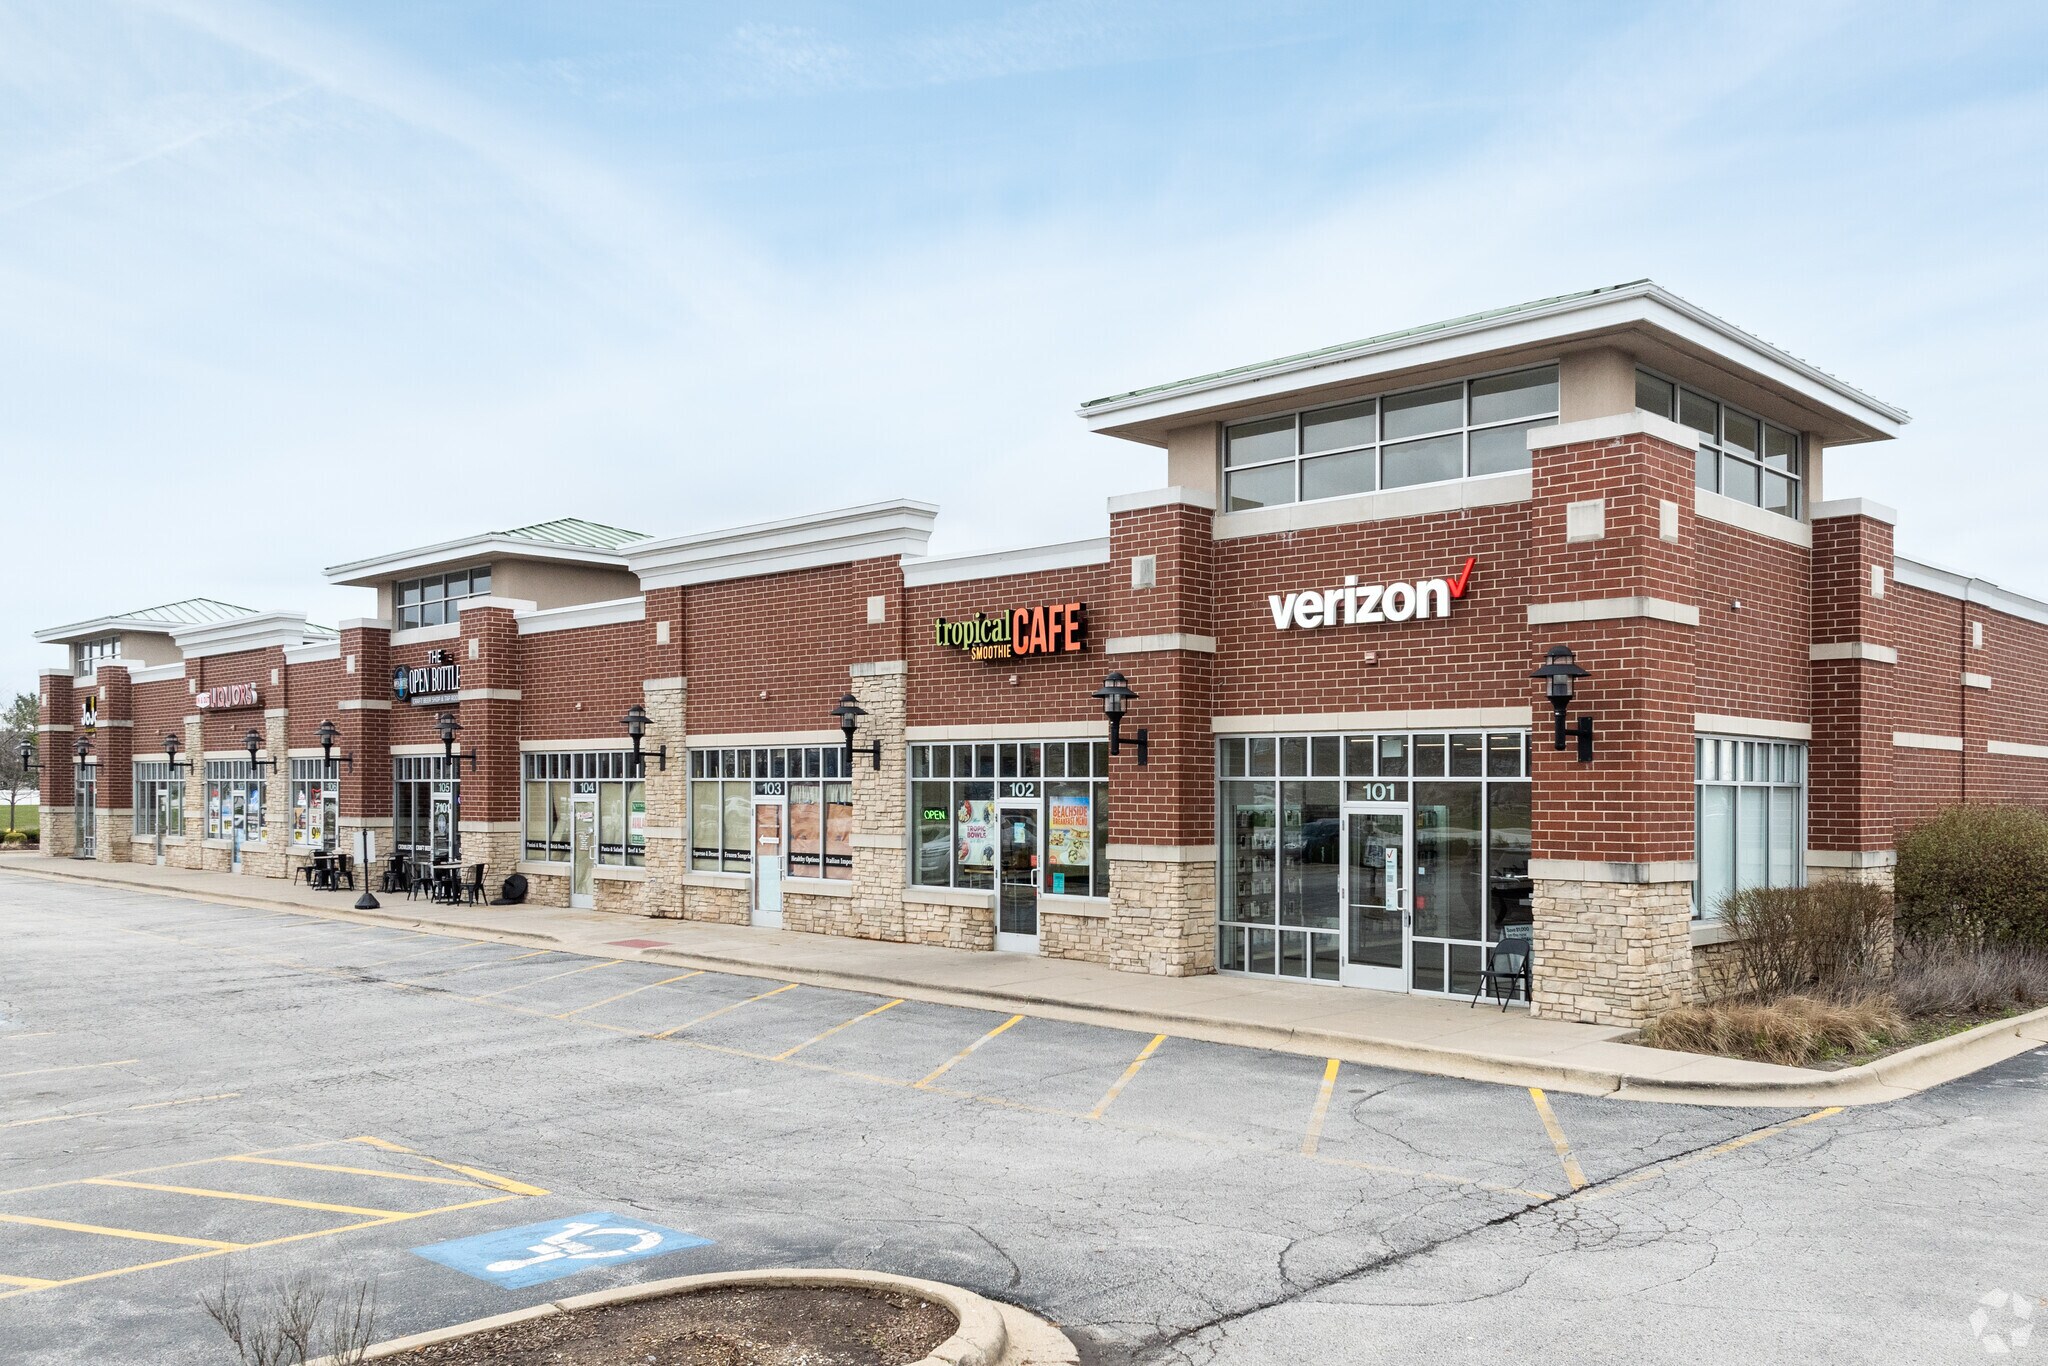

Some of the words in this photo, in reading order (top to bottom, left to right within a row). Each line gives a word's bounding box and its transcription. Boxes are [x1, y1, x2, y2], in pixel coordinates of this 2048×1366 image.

[1268, 574, 1451, 630] verizon
[935, 609, 1011, 650] tropical
[1012, 602, 1083, 655] CAFE
[427, 649, 442, 664] THE
[971, 645, 1012, 660] SMOOTHIE
[408, 667, 430, 694] OPEN
[431, 664, 461, 692] BOTTLE
[210, 682, 258, 708] LIQUORS
[439, 782, 450, 793] 105
[580, 782, 595, 793] 104
[762, 782, 782, 795] 103
[1009, 782, 1035, 797] 102
[1362, 783, 1396, 801] 101
[923, 810, 946, 820] OPEN
[1052, 805, 1088, 817] BEACHSIDE
[1075, 817, 1088, 826] MENU
